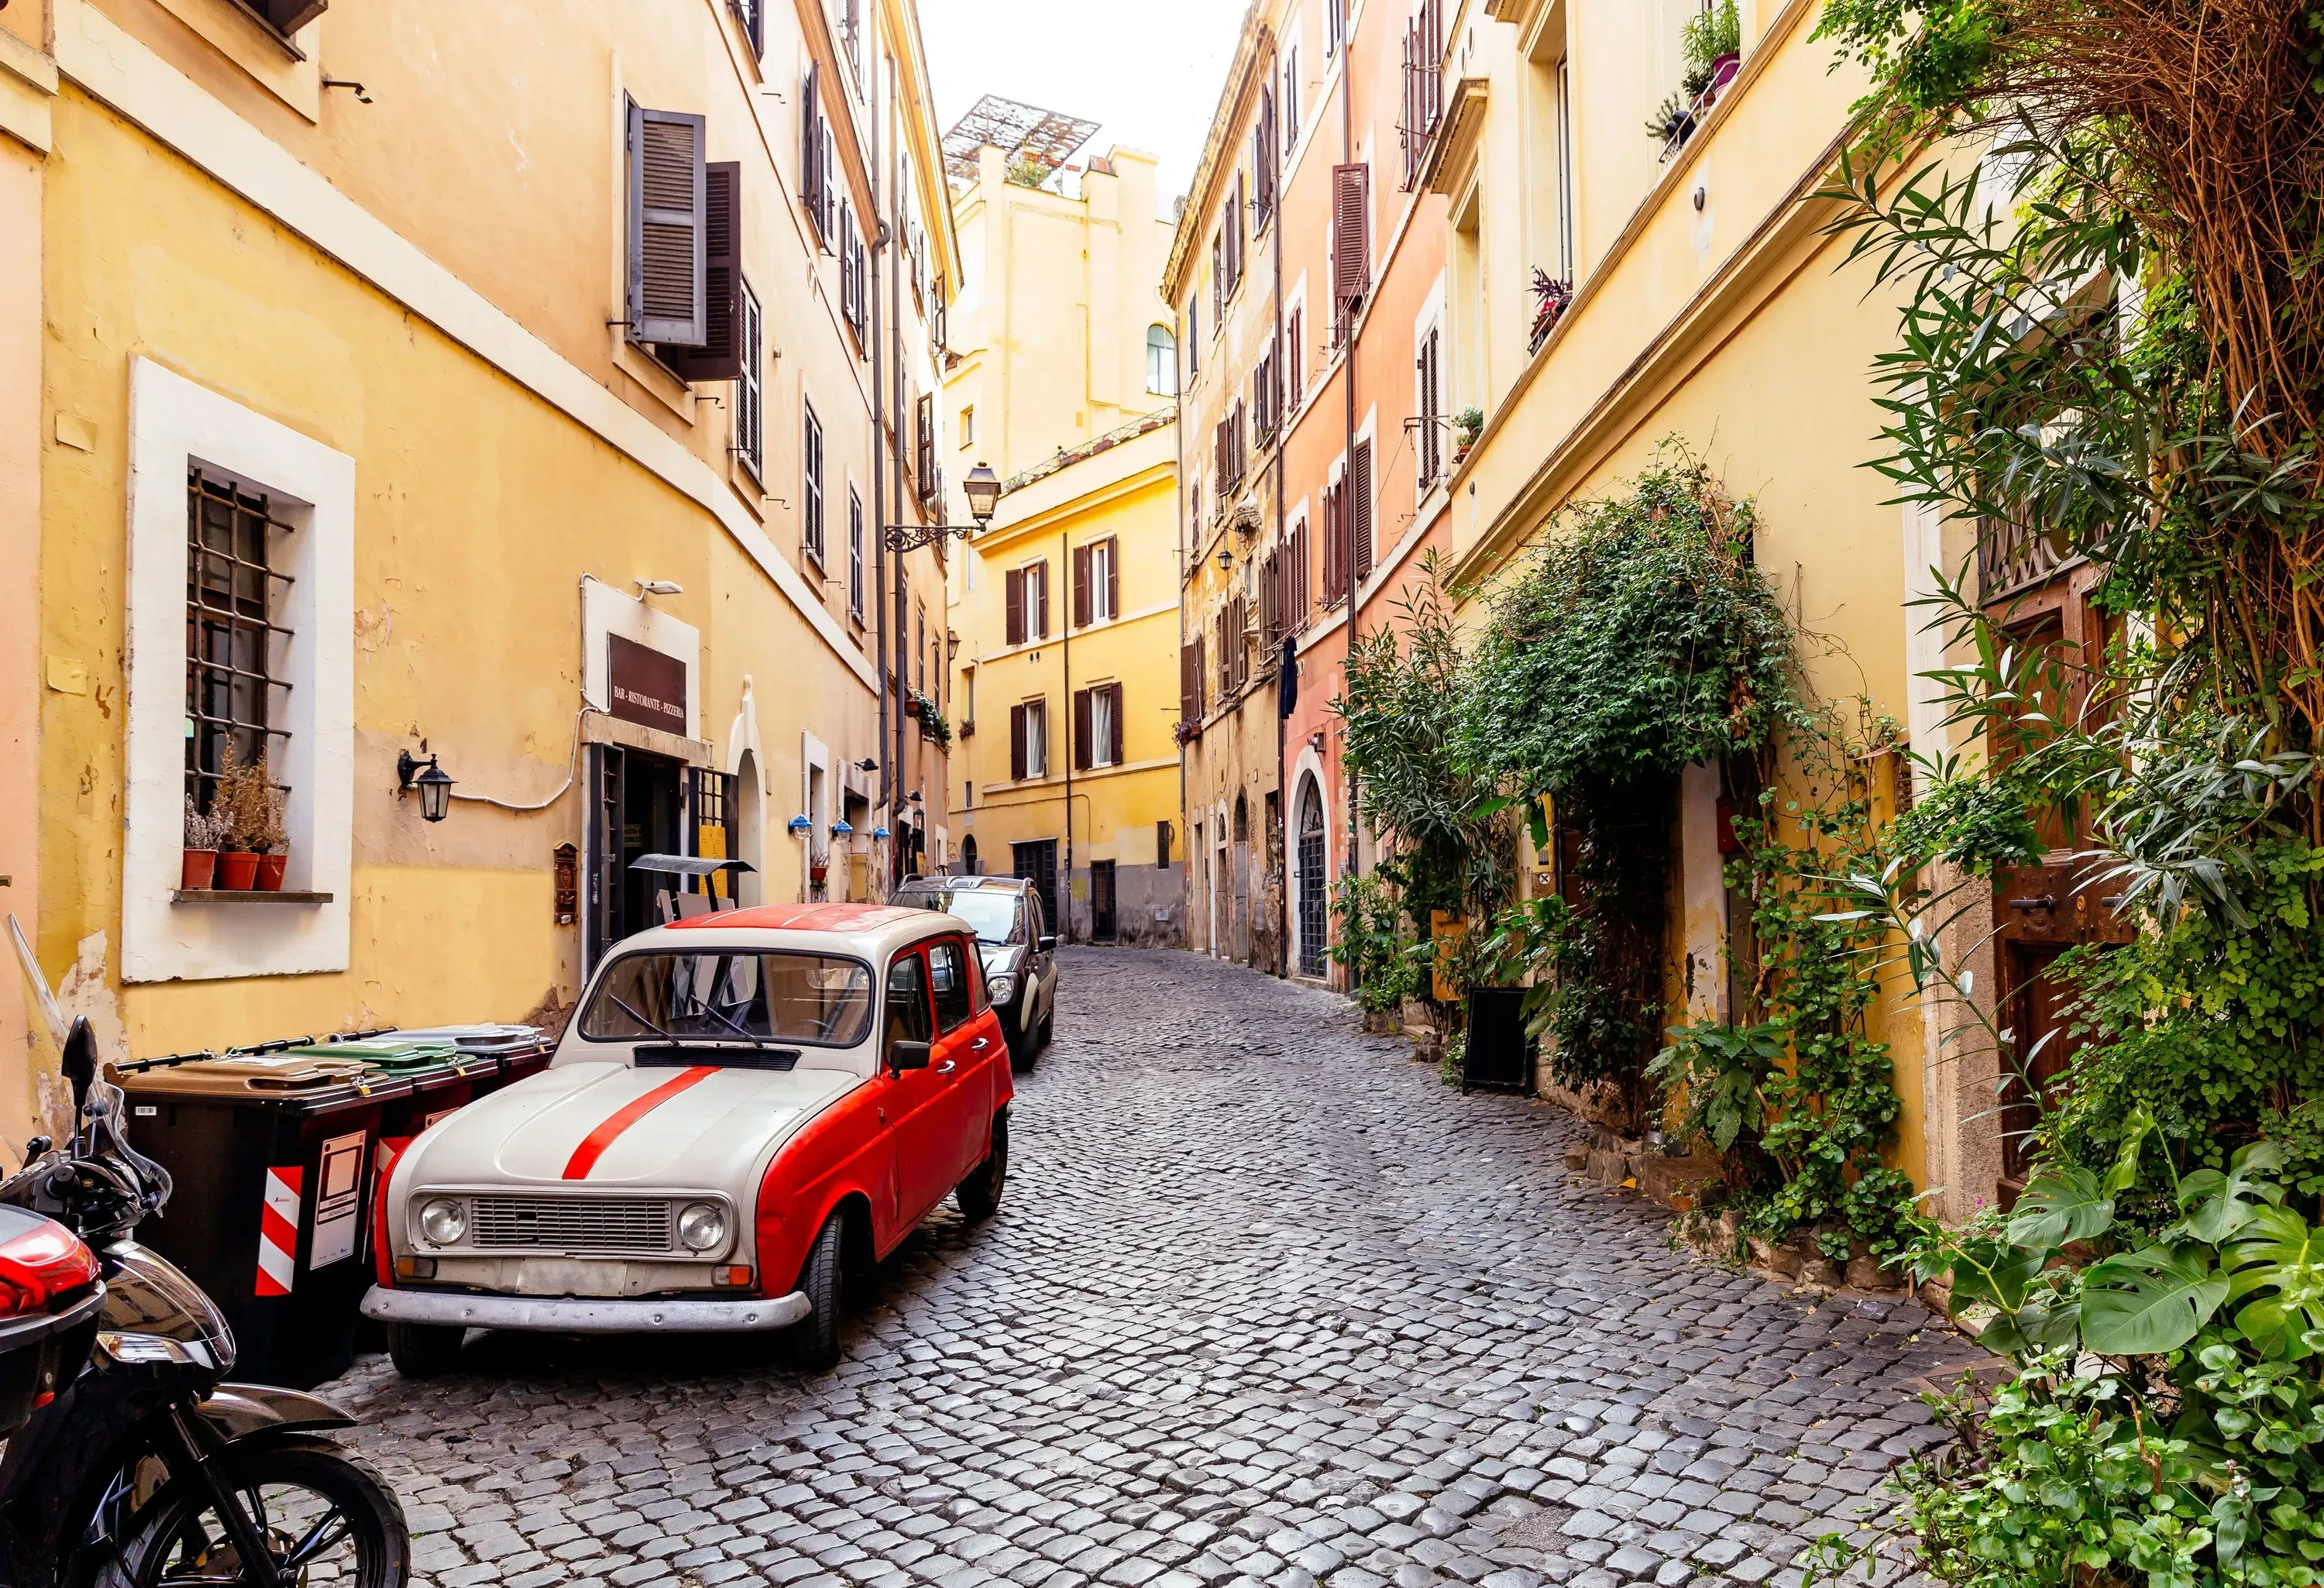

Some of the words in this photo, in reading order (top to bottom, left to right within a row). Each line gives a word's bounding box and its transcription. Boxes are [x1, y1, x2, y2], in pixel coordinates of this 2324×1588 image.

[614, 686, 625, 699] BAR
[628, 690, 660, 711] RISTORANTE
[663, 702, 684, 719] PIZZERIA
[329, 1195, 348, 1205] ORGANICO
